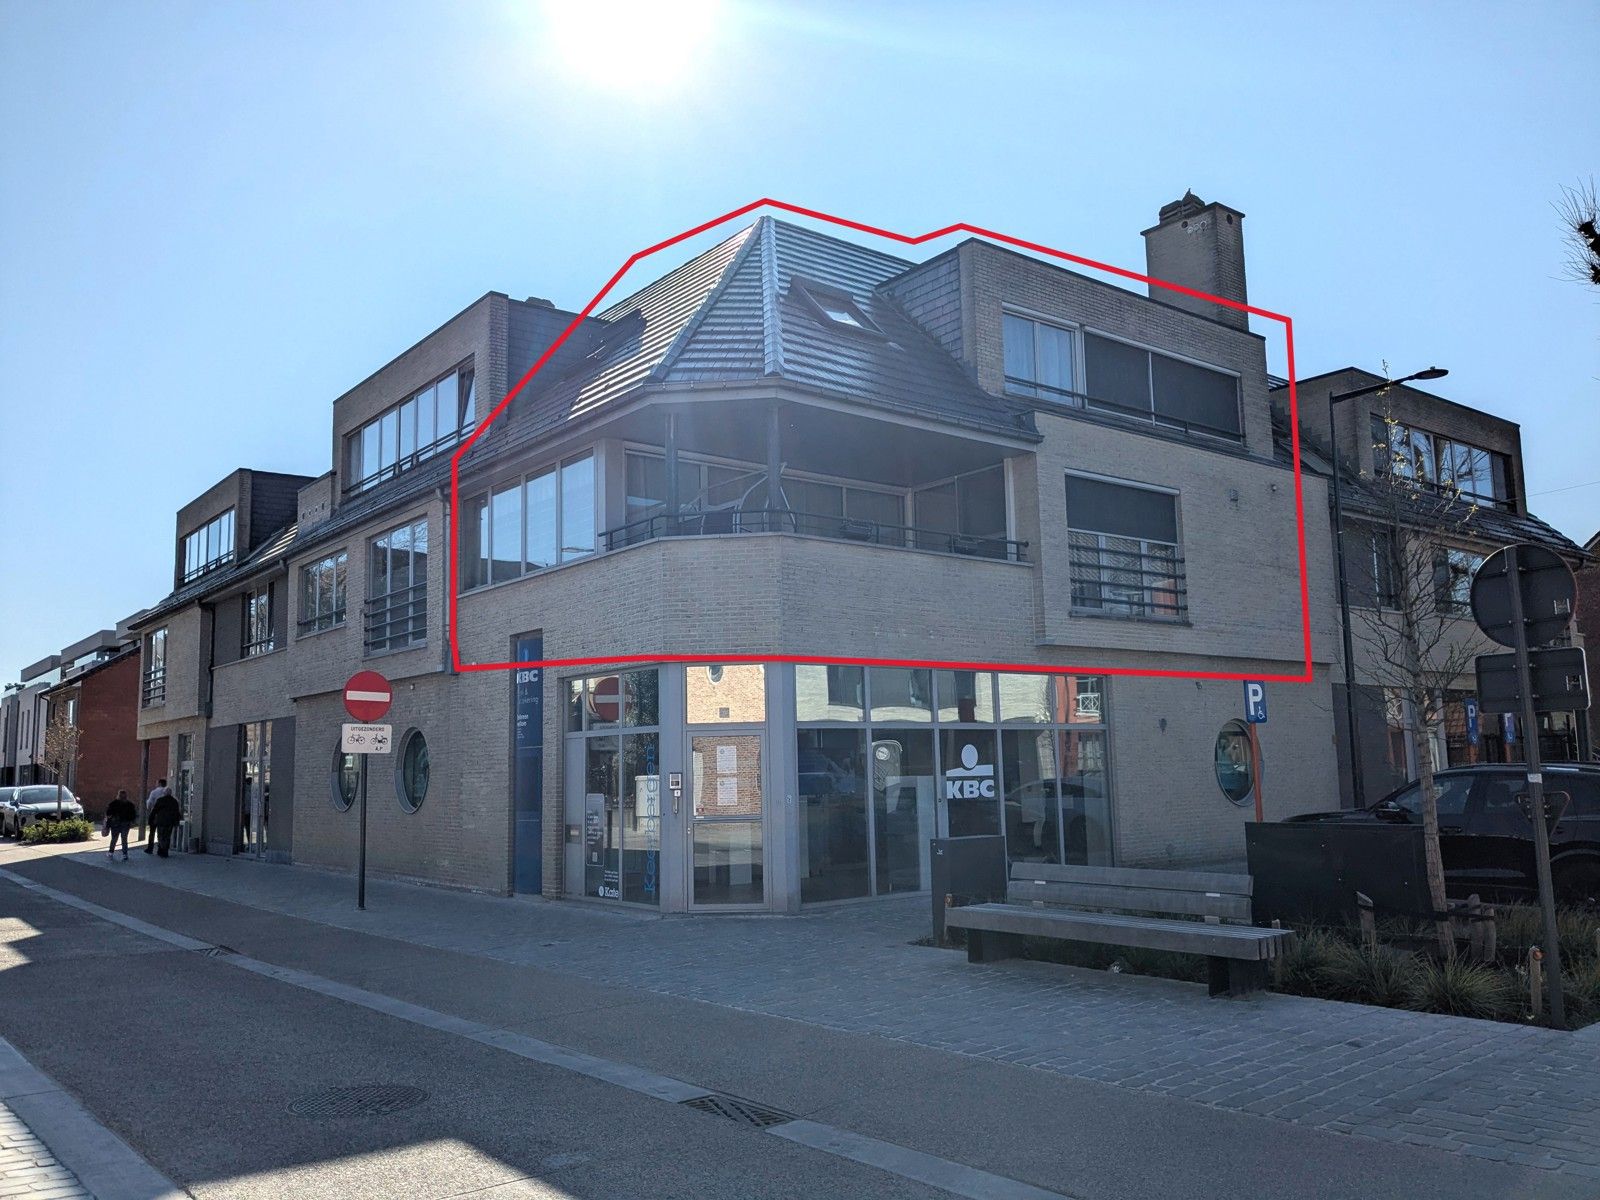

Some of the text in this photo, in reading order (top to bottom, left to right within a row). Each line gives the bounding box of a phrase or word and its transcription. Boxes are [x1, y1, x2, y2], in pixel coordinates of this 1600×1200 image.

[1248, 684, 1262, 715] P
[1468, 705, 1475, 728] P
[946, 780, 994, 799] KBC
